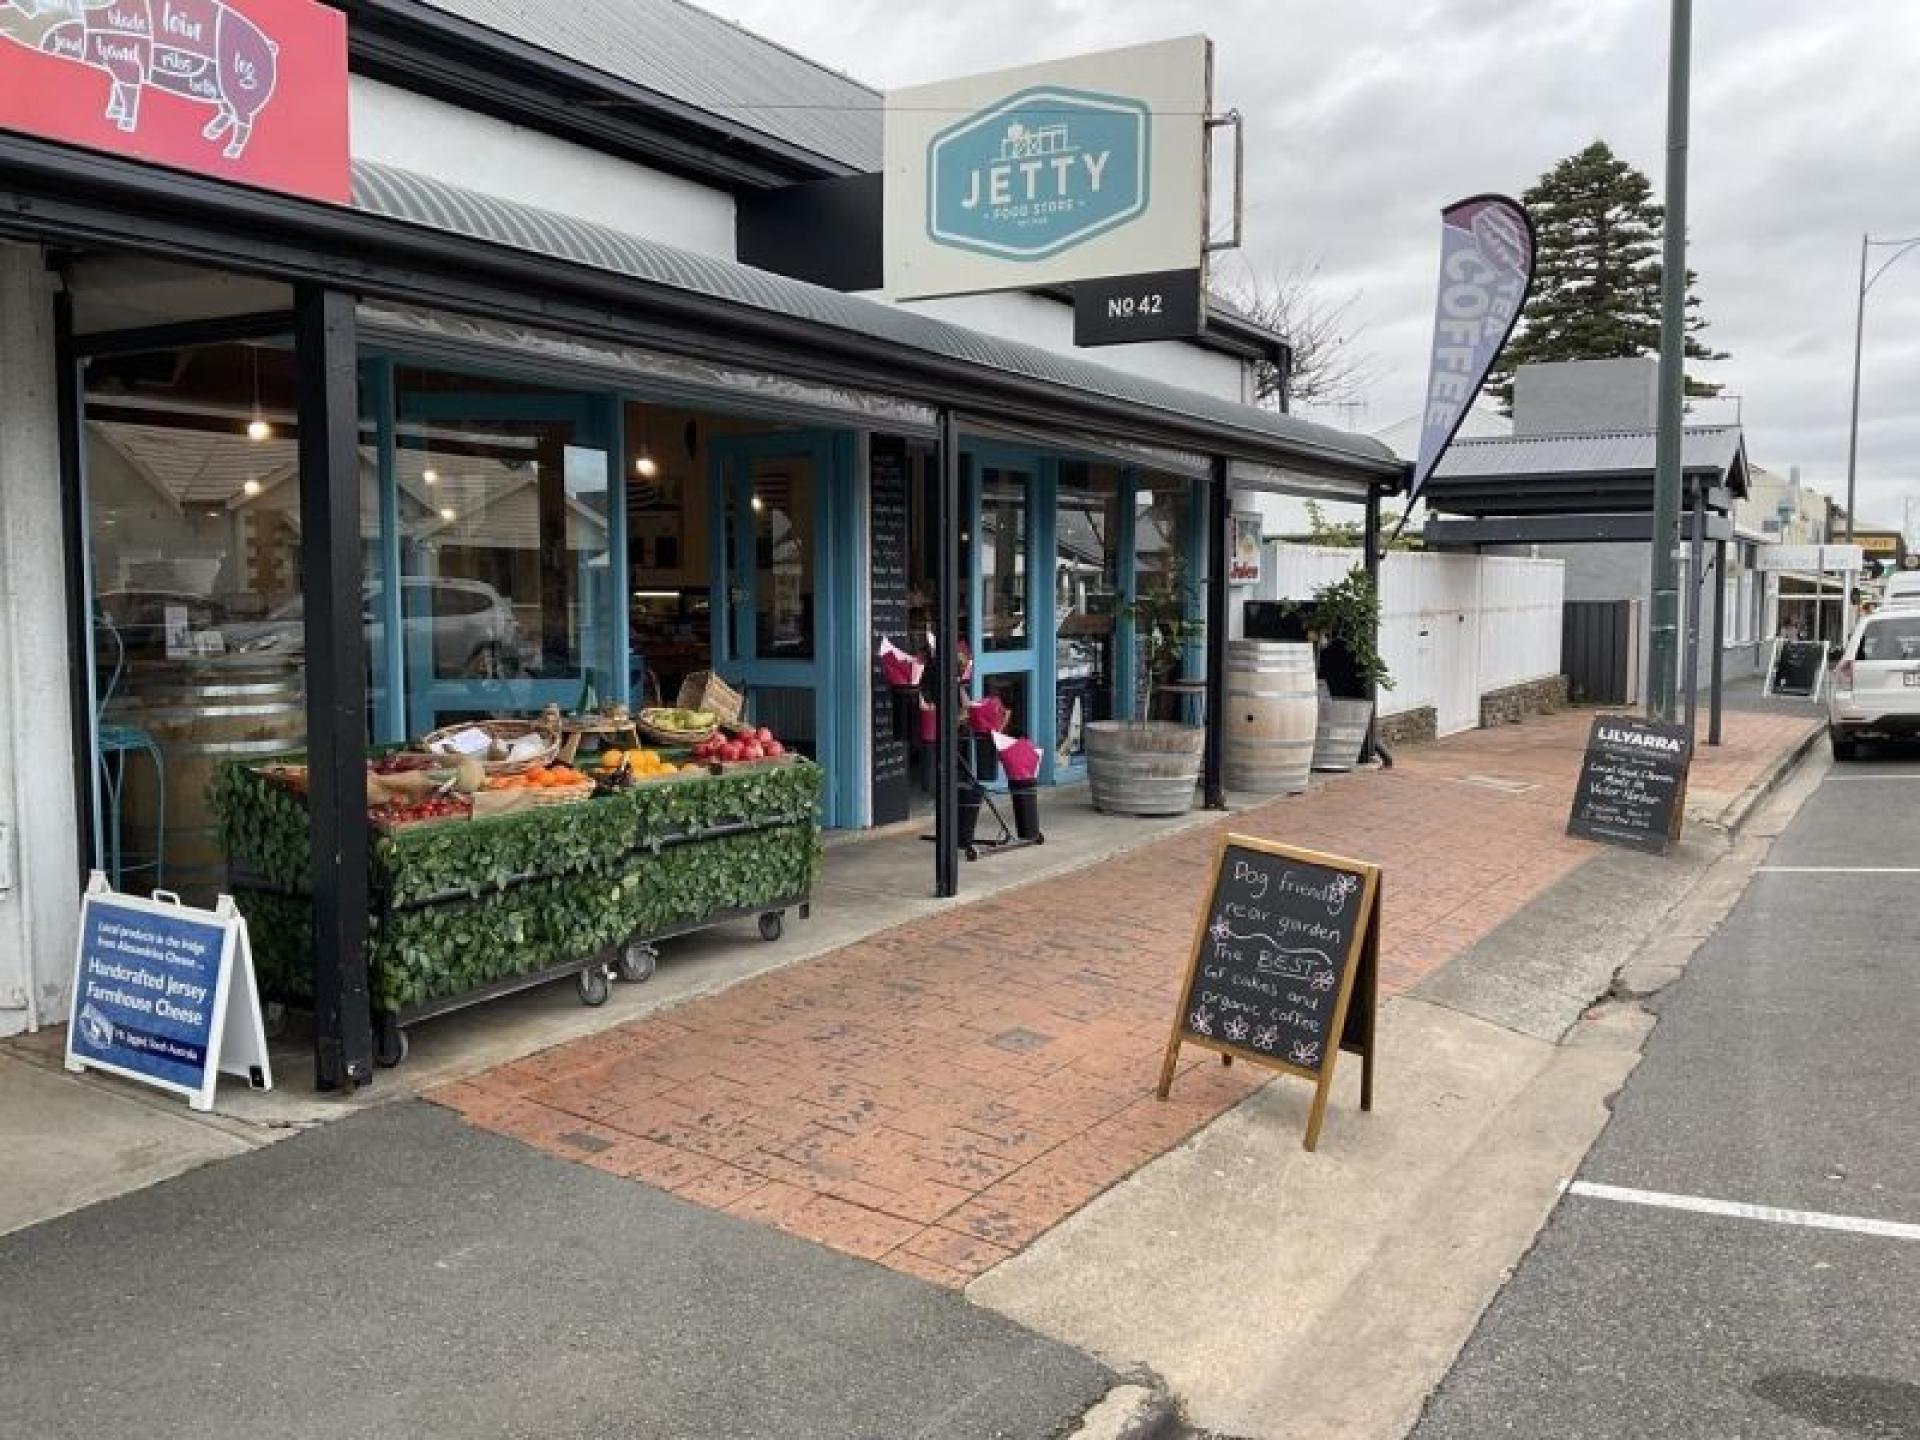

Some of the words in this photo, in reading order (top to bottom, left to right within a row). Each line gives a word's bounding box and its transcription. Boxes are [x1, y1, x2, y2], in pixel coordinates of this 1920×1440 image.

[162, 1, 202, 41] loin
[234, 53, 258, 90] leg
[961, 151, 1111, 210] JETTY
[993, 206, 1028, 220] FOOD
[1138, 294, 1163, 315] 42
[1425, 249, 1495, 426] COFFEE
[1597, 726, 1680, 752] LILYARRA
[1234, 861, 1268, 898] Dog
[1225, 902, 1272, 921] rear
[1277, 916, 1341, 944] garden
[1214, 942, 1245, 961] The
[1257, 950, 1319, 976] BEST
[87, 956, 164, 989] Handcrafted
[165, 976, 208, 1005] Jersey
[1232, 974, 1279, 997] cakes
[1288, 991, 1320, 1011] and
[86, 981, 152, 1013] Farmhouse
[155, 998, 203, 1025] Cheese
